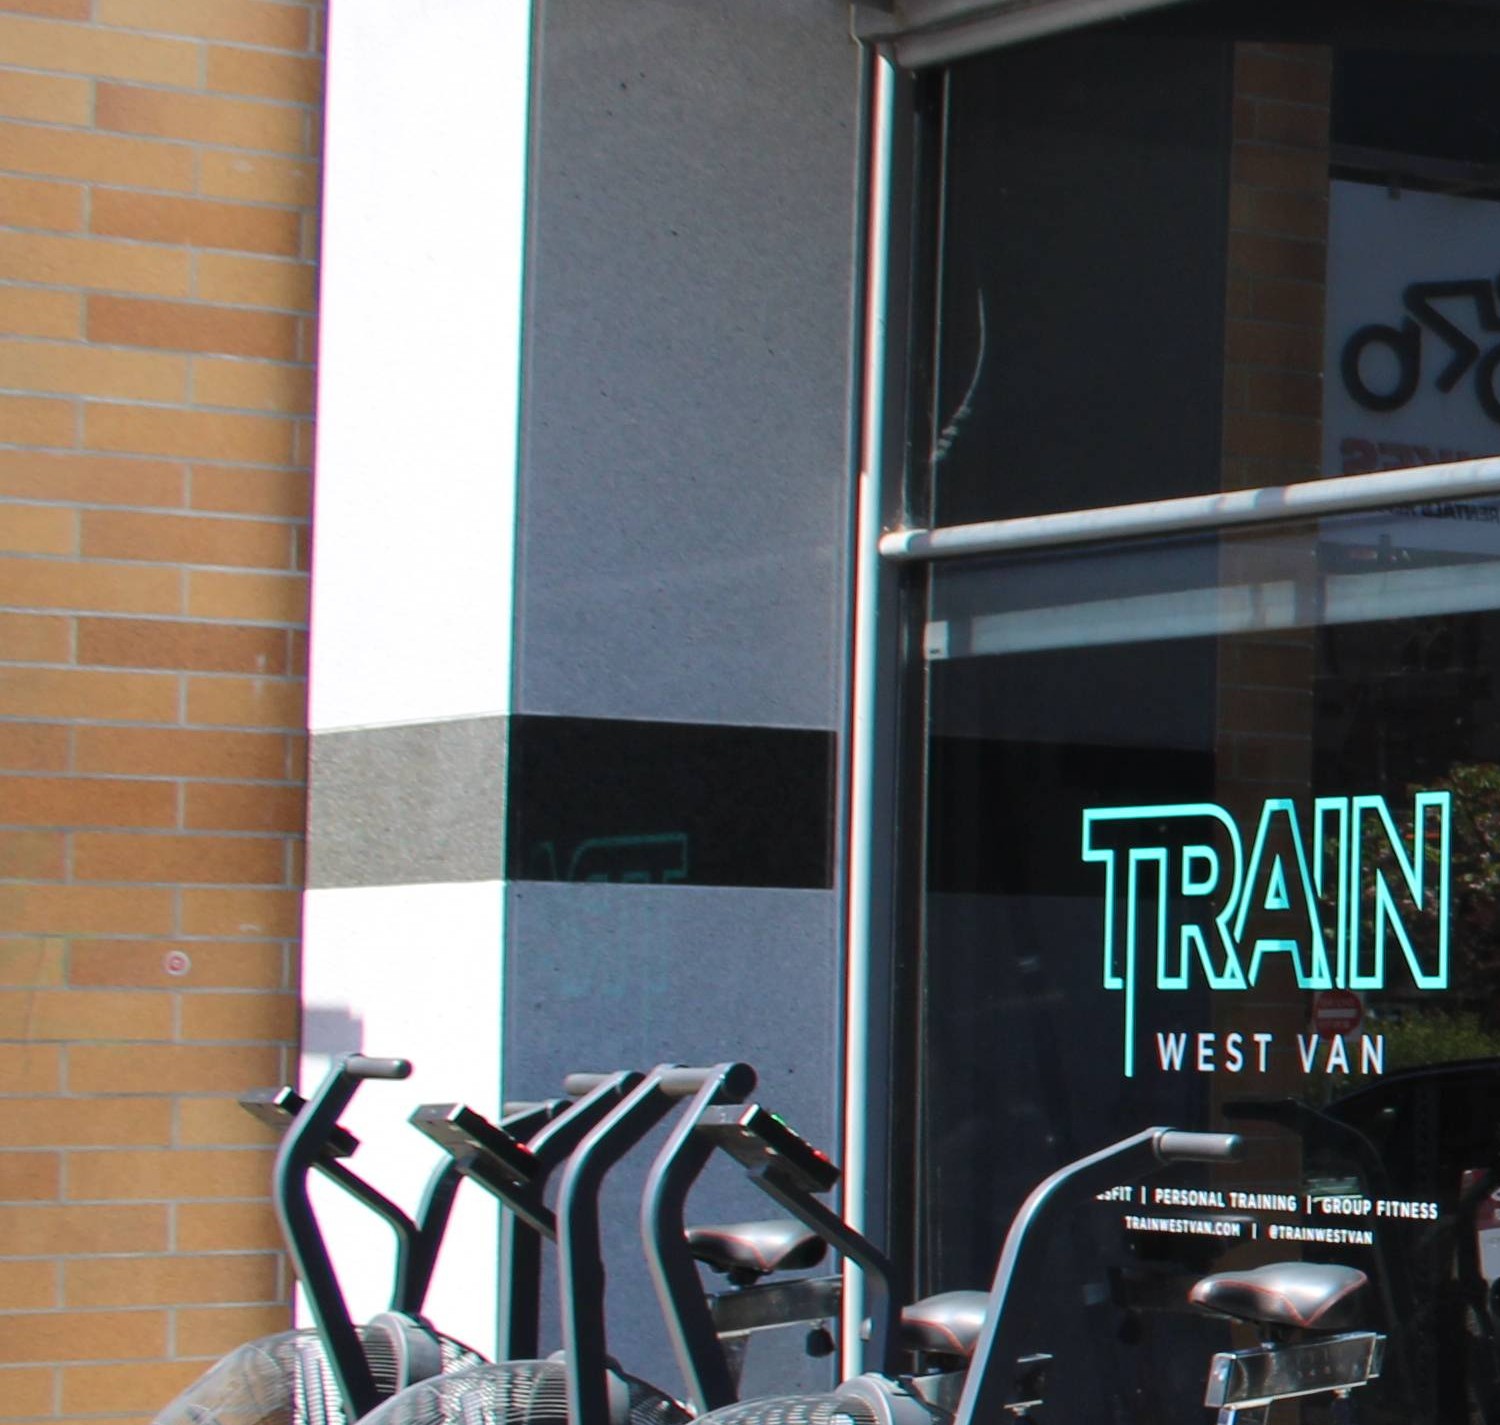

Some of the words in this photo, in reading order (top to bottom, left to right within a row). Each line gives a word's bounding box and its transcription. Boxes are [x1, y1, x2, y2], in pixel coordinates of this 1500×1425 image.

[1082, 791, 1452, 1077] TRAIN
[1157, 1033, 1273, 1073] WEST
[1298, 1034, 1385, 1075] VAN
[1155, 1188, 1227, 1208] PERSONAL
[1230, 1192, 1297, 1212] TRAINING
[1323, 1197, 1373, 1217] GROUP
[1376, 1200, 1438, 1220] FITNESS
[1124, 1216, 1240, 1237] TRAINWESTVAN.COM
[1269, 1224, 1373, 1246] @TRAINWESTVAN
